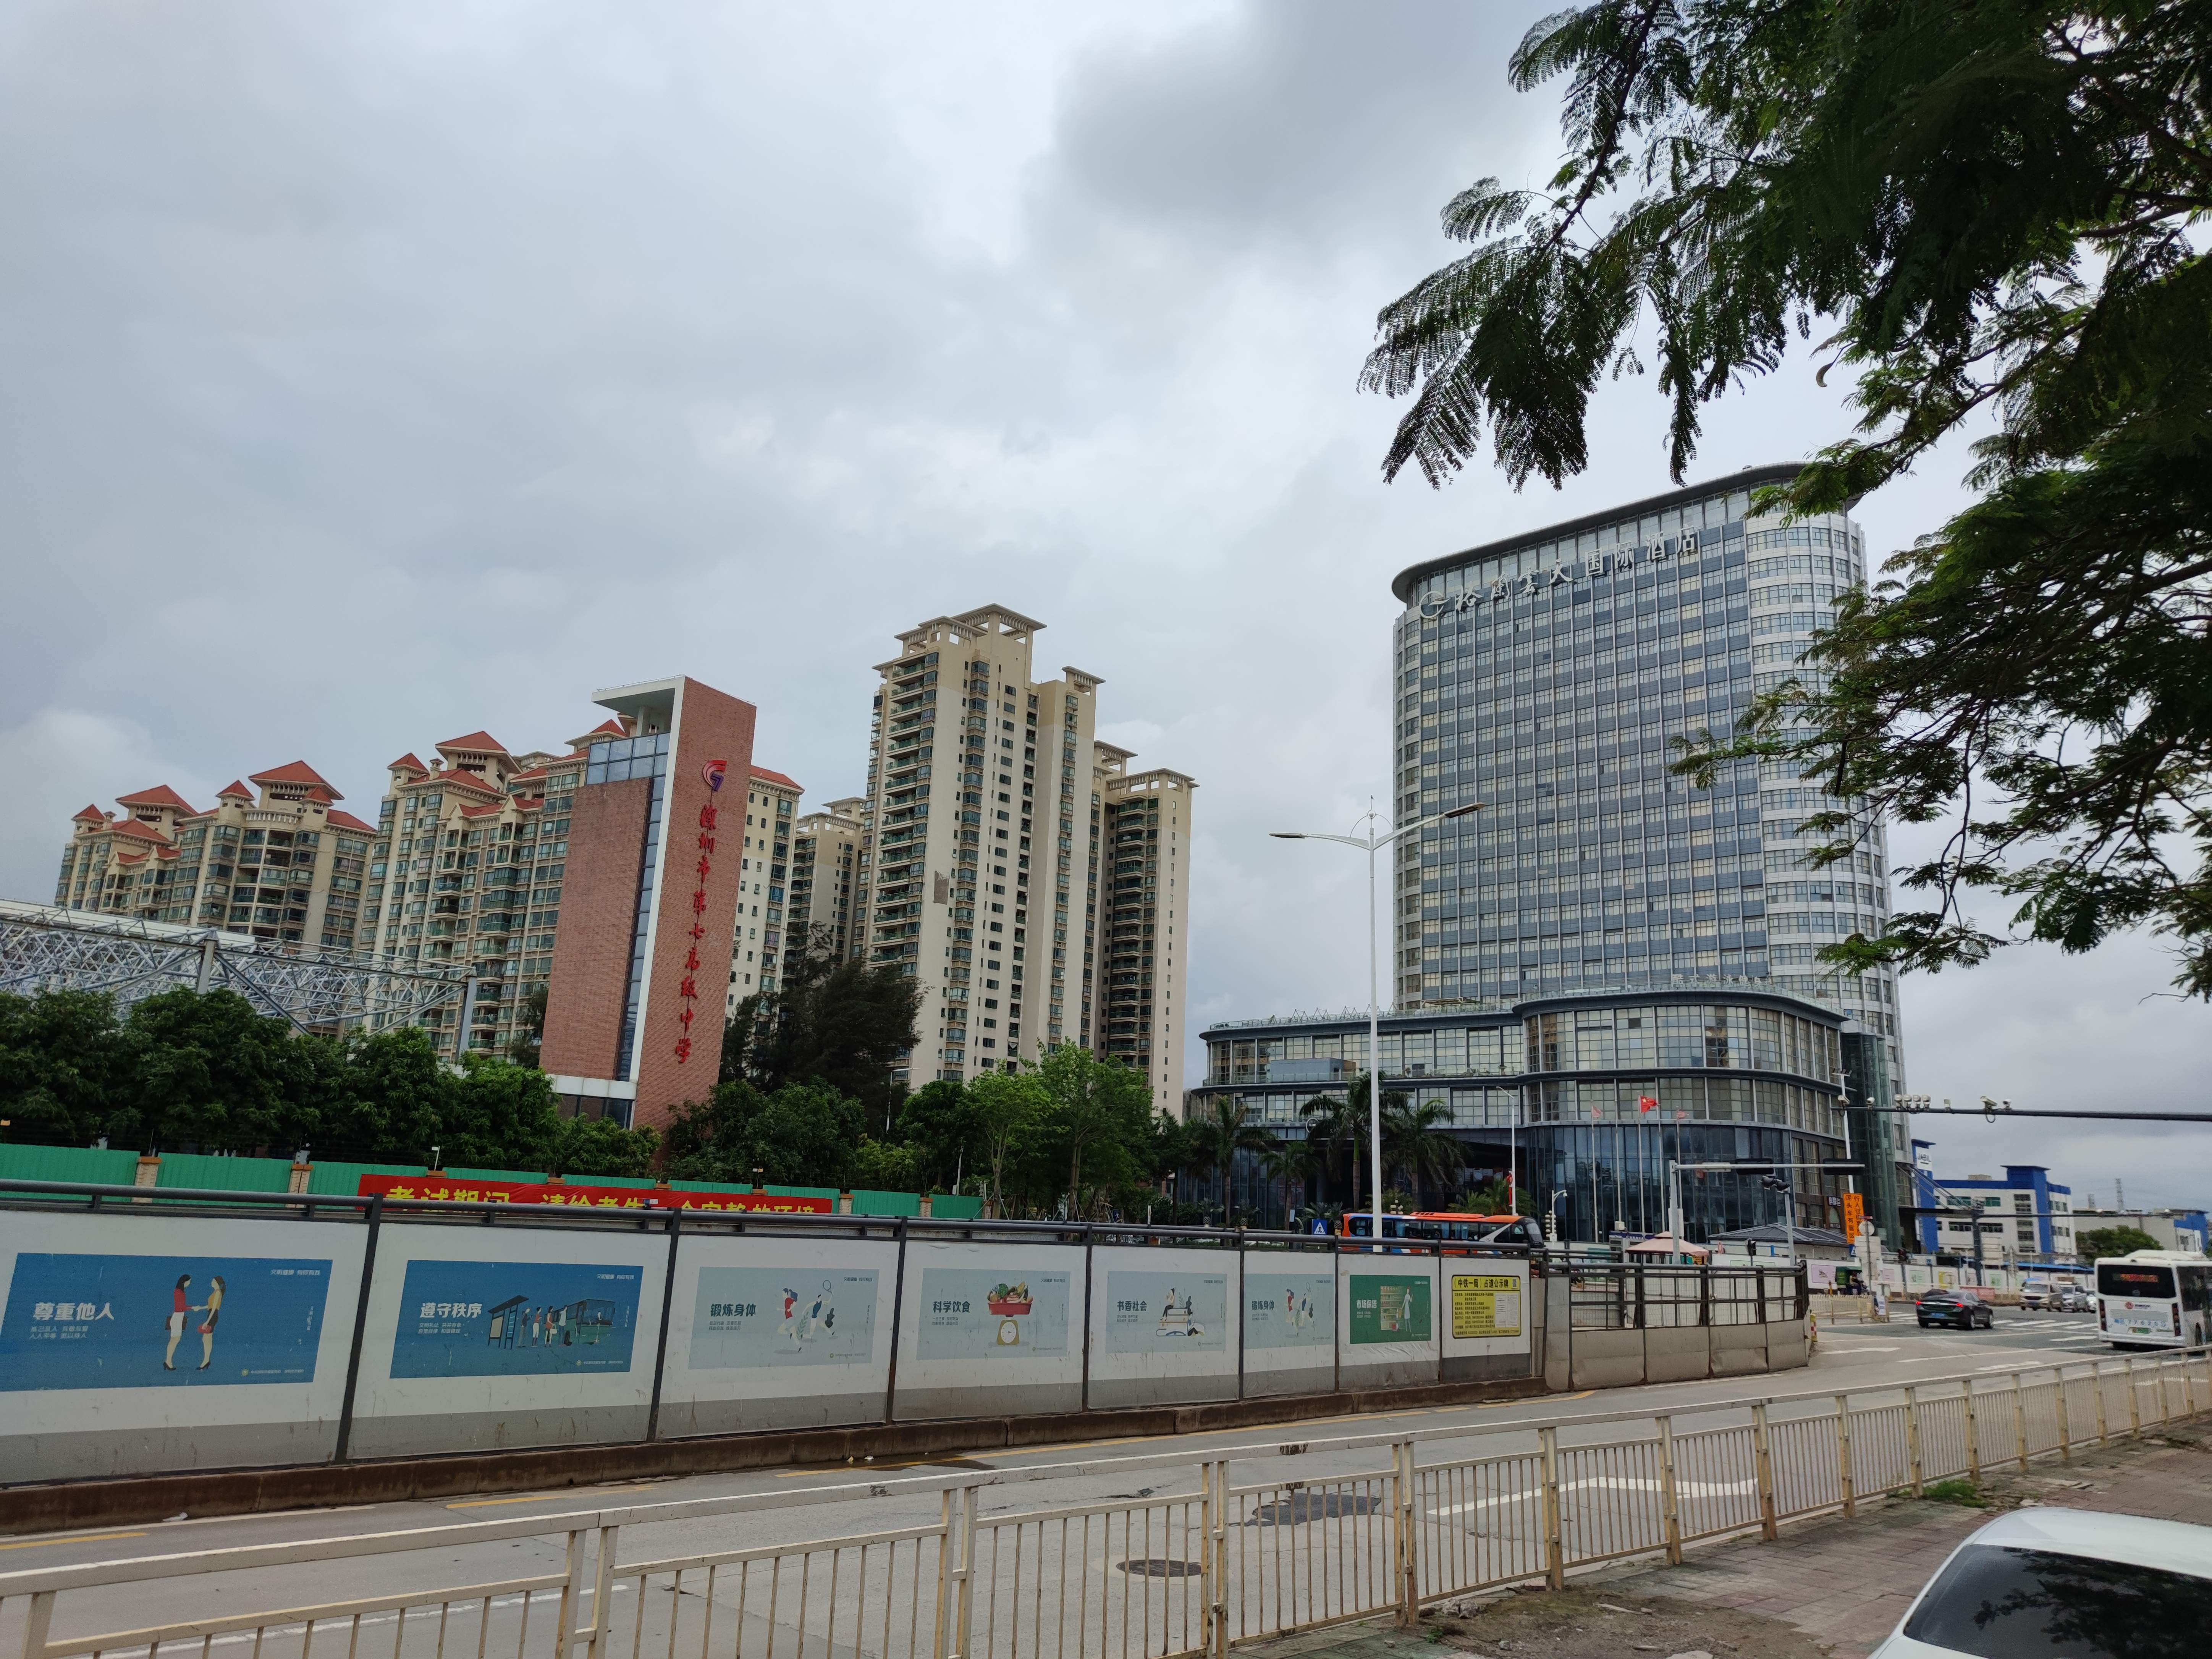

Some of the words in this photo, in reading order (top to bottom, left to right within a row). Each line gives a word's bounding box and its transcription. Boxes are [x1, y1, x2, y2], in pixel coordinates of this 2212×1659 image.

[675, 804, 718, 1063] 深圳市第七高级中学
[420, 1302, 482, 1318] 遵守秩序
[710, 1303, 756, 1317] 锻炼身体
[933, 1301, 970, 1313] 科学饮食
[1117, 1300, 1147, 1311] 书香社会
[1252, 1300, 1274, 1310] 锻炼身体
[1356, 1299, 1377, 1309] 市场保洁
[33, 1302, 114, 1320] 尊重他人
